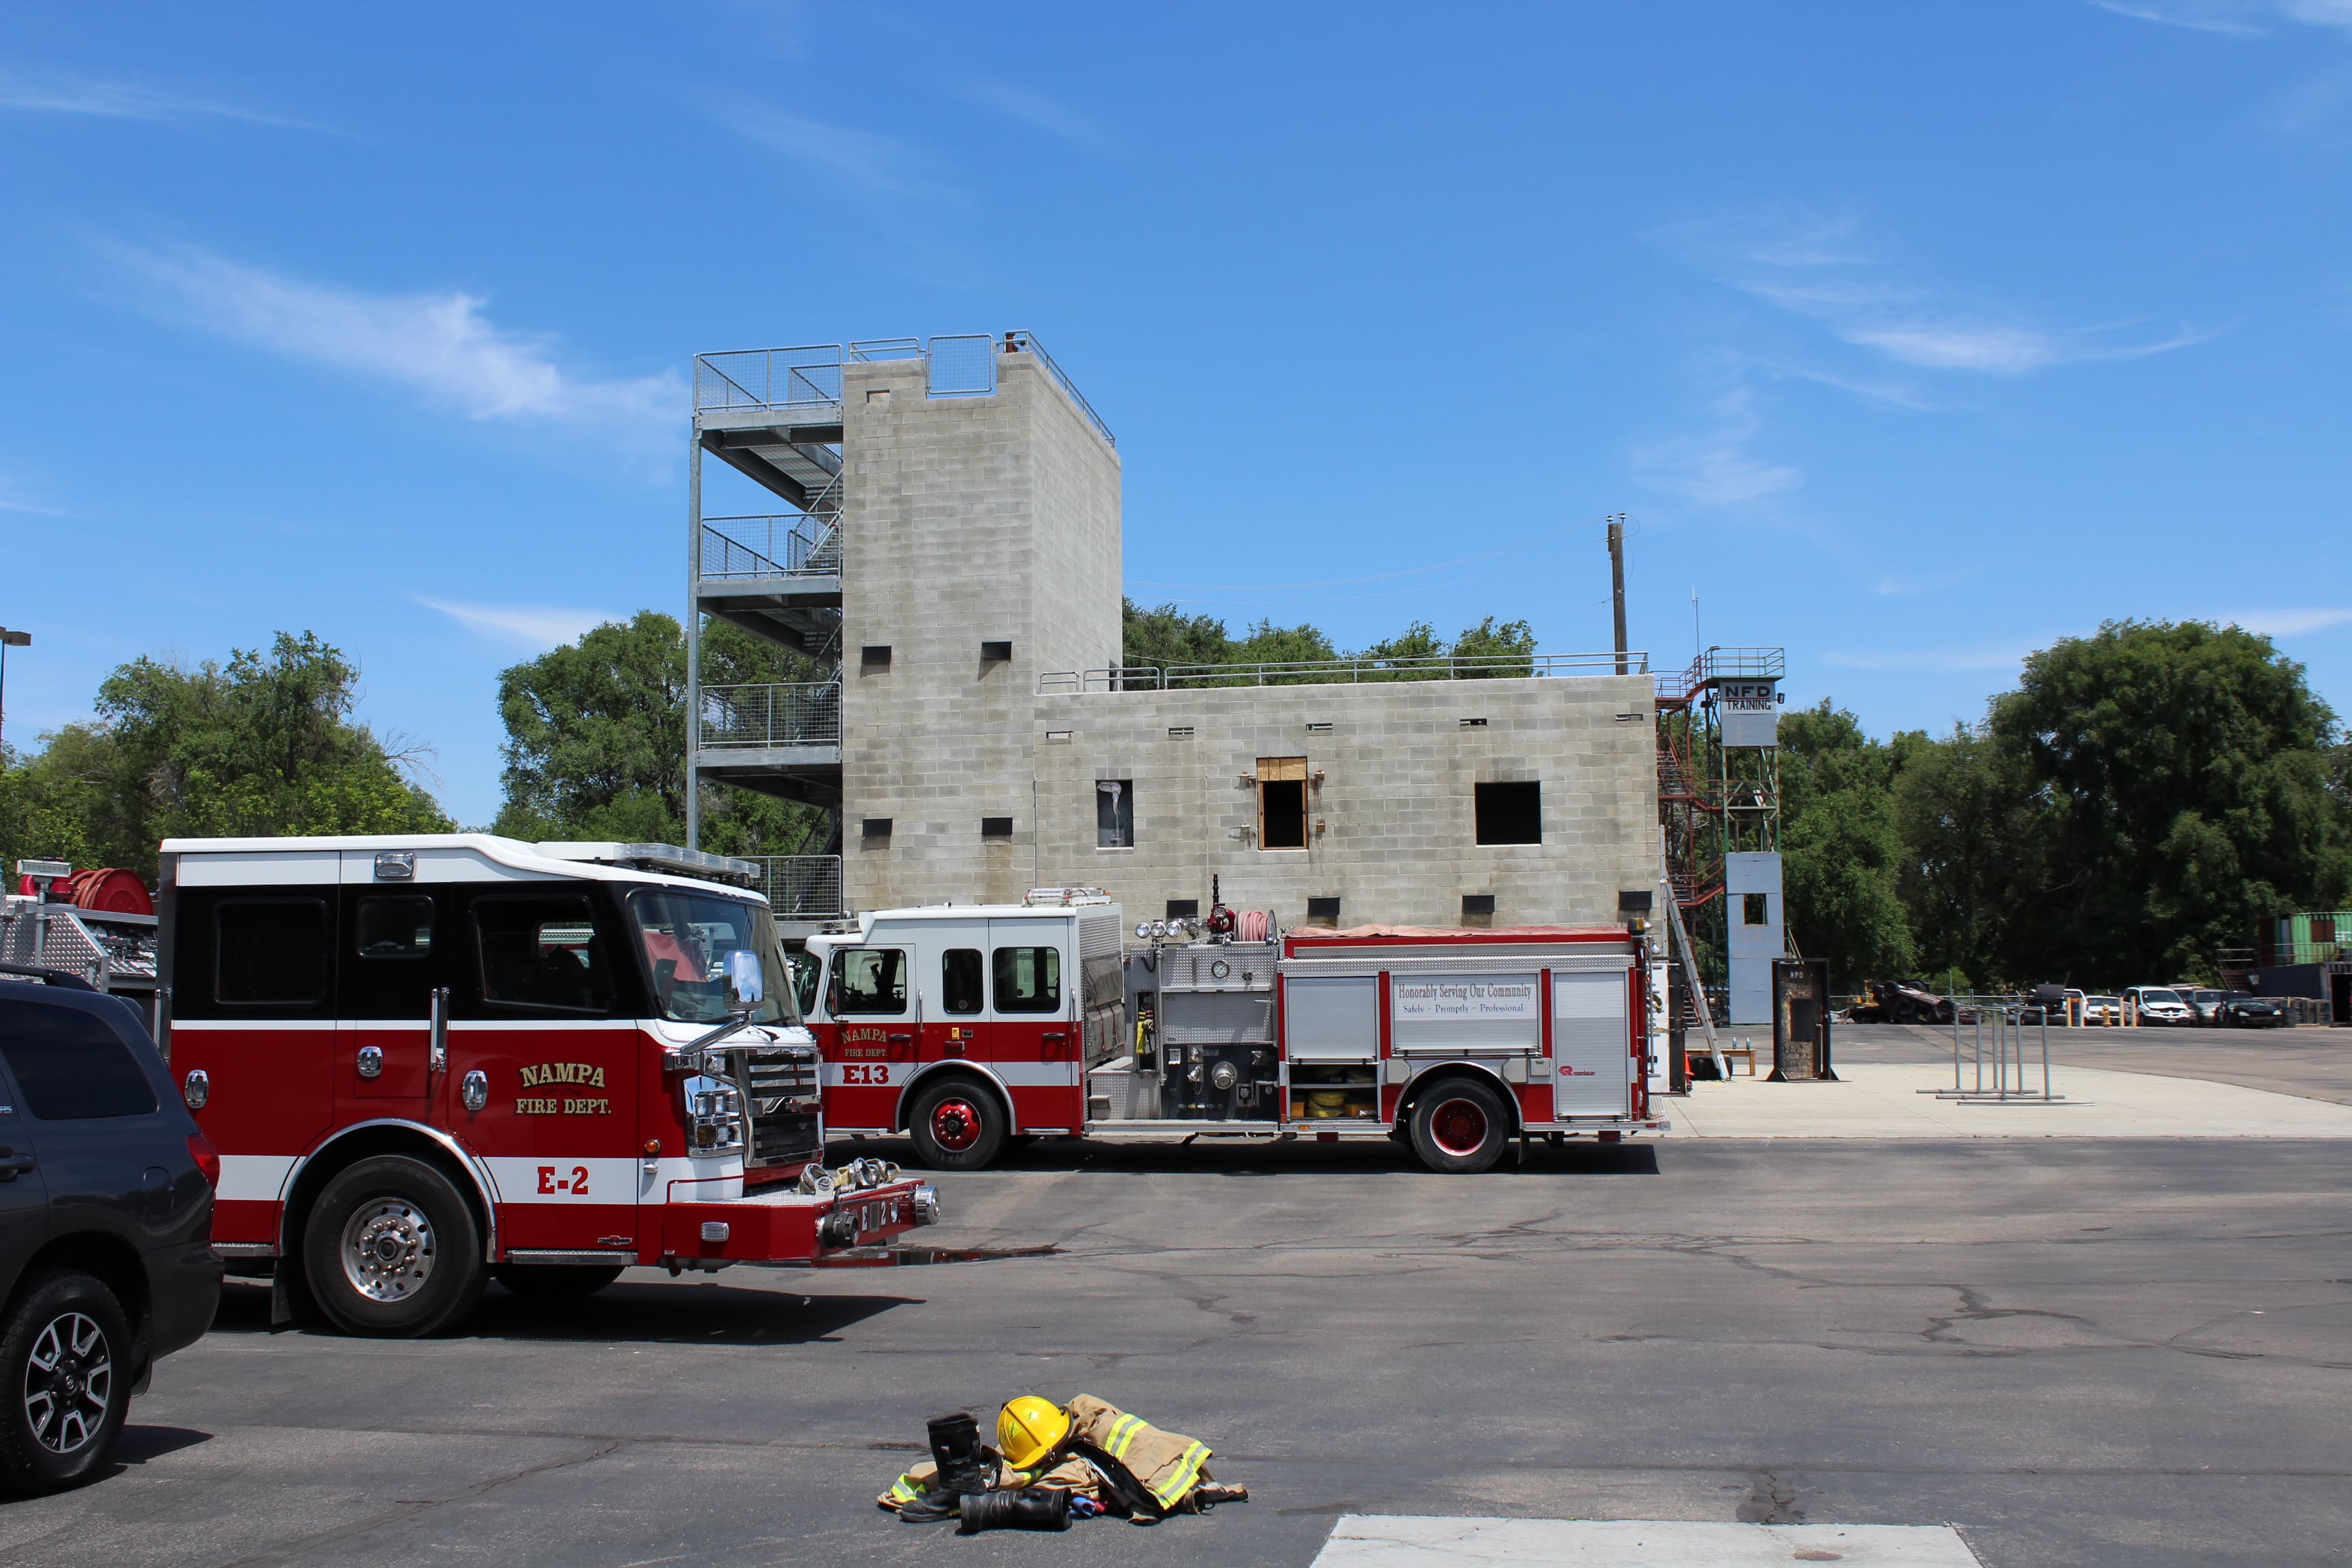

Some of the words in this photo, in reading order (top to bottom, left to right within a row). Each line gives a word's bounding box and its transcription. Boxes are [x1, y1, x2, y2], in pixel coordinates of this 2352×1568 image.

[1725, 685, 1771, 698] NFD
[1725, 700, 1771, 710] TRAINING
[1399, 983, 1437, 1001] Honorably
[1439, 983, 1467, 1000] Serving
[1470, 983, 1485, 998] Our
[1487, 983, 1531, 1000] Community
[1403, 1004, 1424, 1013] Safely
[1435, 1004, 1469, 1014] Promptly
[1480, 1003, 1523, 1012] Professional
[840, 1028, 887, 1044] NAMPA
[845, 1049, 863, 1057] FIRE
[866, 1049, 887, 1057] DEPT.
[520, 1062, 605, 1088] NAMPA
[843, 1065, 889, 1084] E13
[516, 1098, 557, 1114] FIRE
[564, 1098, 611, 1114] DEPT.
[537, 1166, 589, 1195] E-2
[881, 1200, 886, 1226] 2
